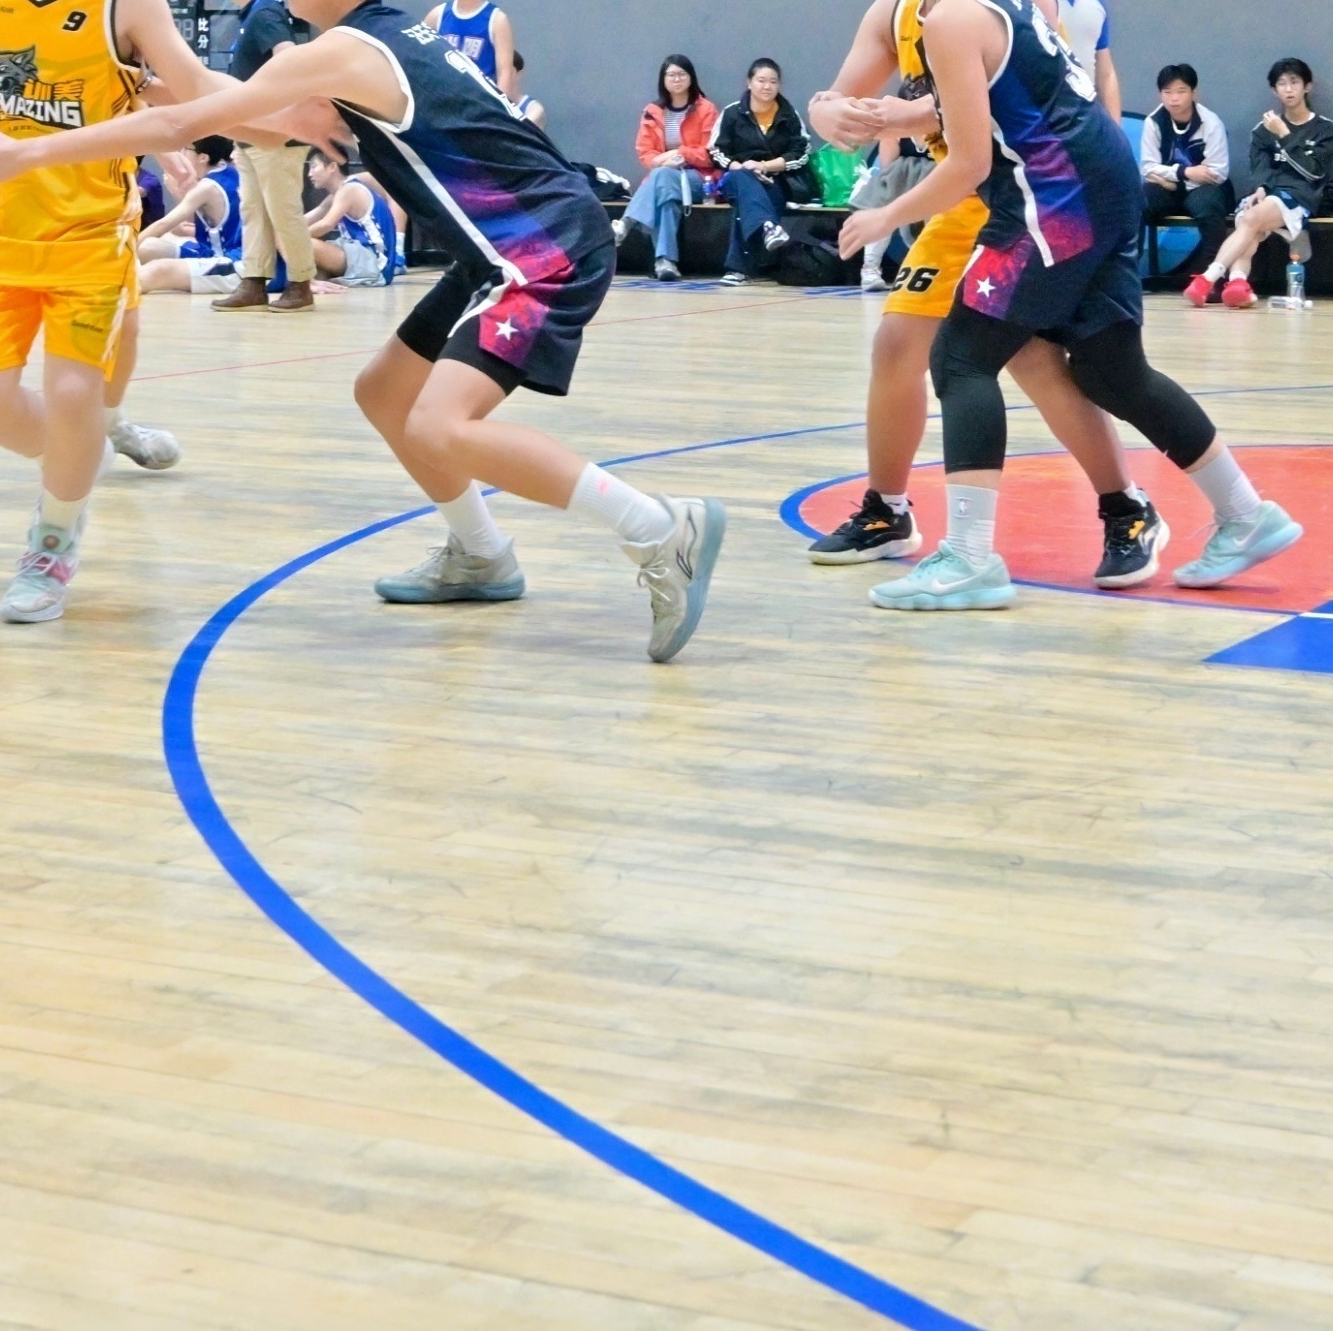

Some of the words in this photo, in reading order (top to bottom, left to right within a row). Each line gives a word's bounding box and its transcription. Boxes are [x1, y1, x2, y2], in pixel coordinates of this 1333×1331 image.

[61, 10, 88, 32] 9
[197, 17, 209, 49] 比分
[890, 265, 941, 293] 26
